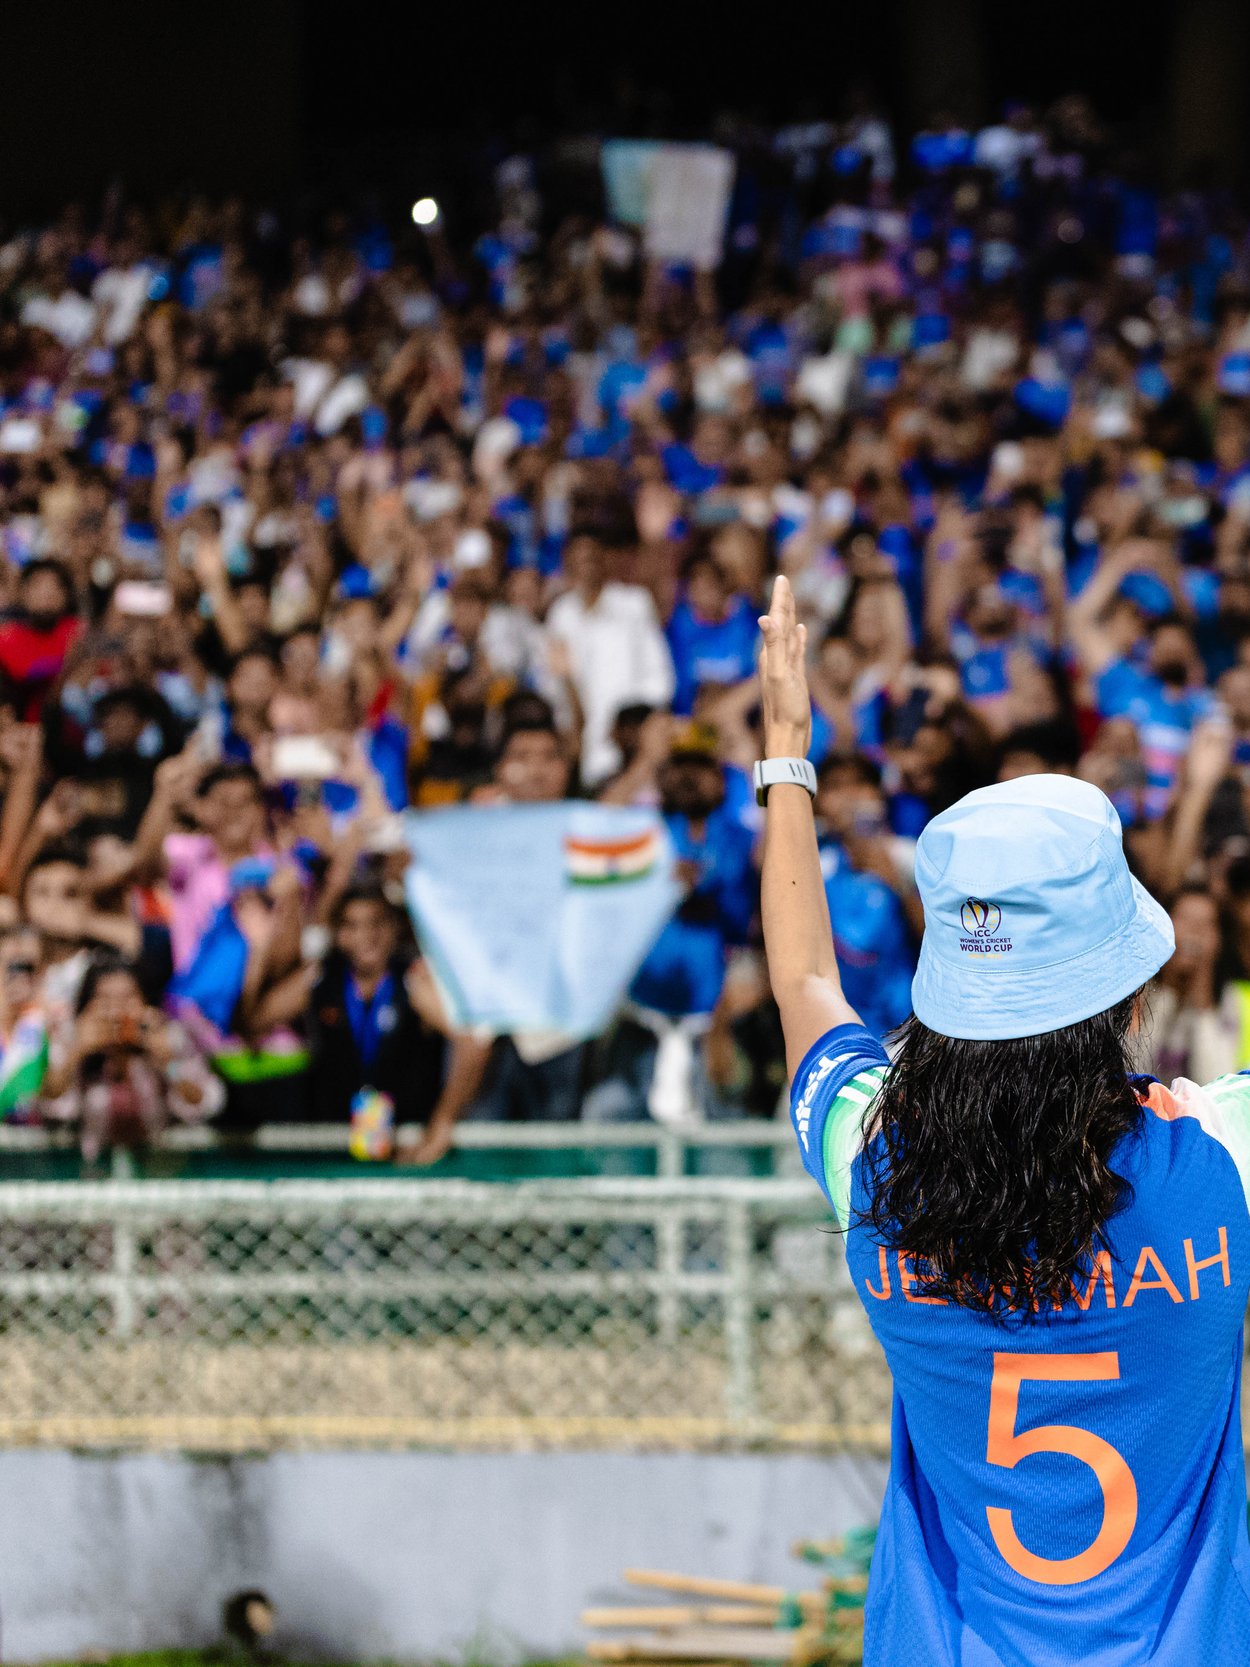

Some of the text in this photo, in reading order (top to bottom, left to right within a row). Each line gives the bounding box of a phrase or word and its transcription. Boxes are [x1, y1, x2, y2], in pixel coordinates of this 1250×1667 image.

[960, 944, 1012, 952] WORLD CUP
[986, 1352, 1138, 1585] 5
